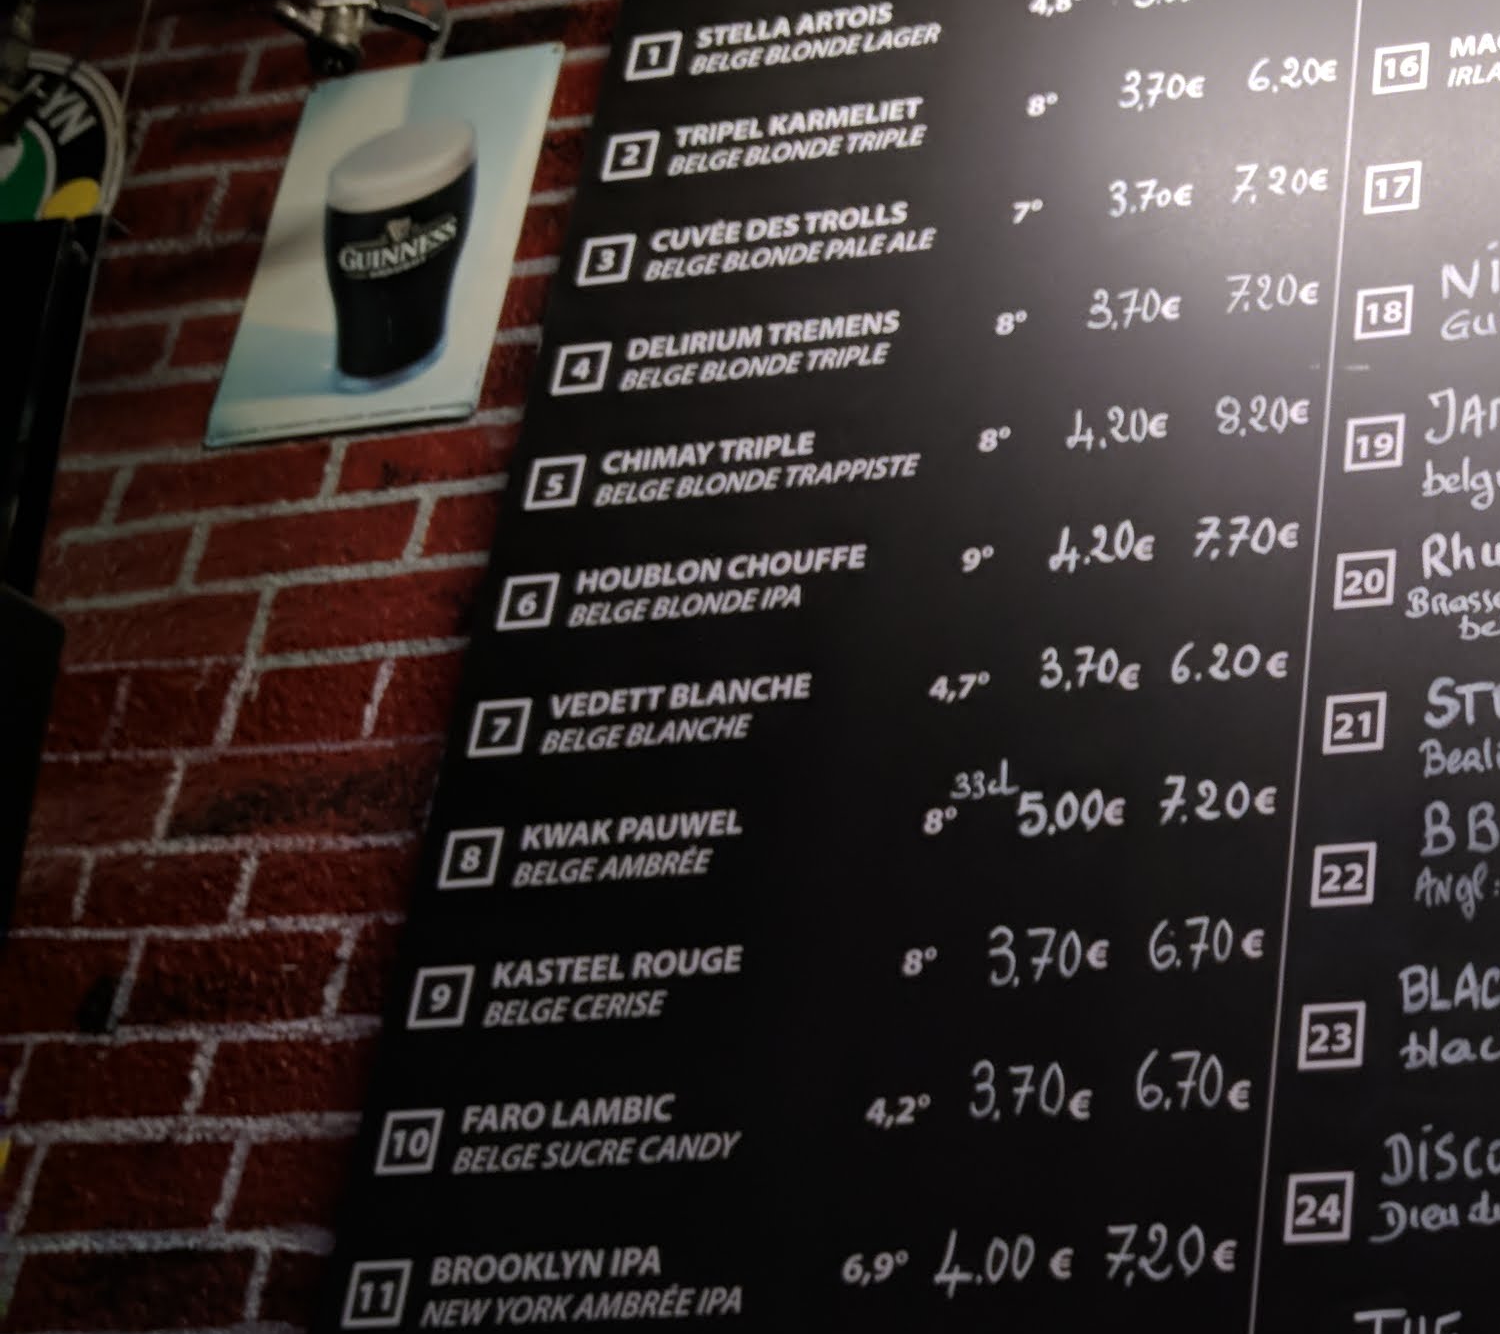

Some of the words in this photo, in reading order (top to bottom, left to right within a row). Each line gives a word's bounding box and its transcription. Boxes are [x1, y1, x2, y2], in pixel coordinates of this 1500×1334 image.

[694, 15, 792, 50] STELLA
[793, 1, 894, 37] ARTOIS
[688, 45, 766, 77] BELGE
[762, 32, 864, 67] BLONDE
[860, 21, 943, 54] LAGER
[674, 116, 765, 149] TRIPEL
[766, 95, 925, 138] KARMELIET
[666, 146, 745, 178] BELGE
[741, 133, 845, 168] BLONDE
[845, 123, 928, 155] TRIPLE
[1373, 171, 1416, 201] 17
[337, 216, 458, 273] GUINNESS
[649, 218, 744, 254] CUVÉE
[743, 213, 801, 243] DES
[803, 200, 909, 236] TROLLS
[642, 251, 723, 283] BELGE
[719, 239, 825, 274] BLONDE
[822, 232, 889, 262] PALE
[884, 226, 938, 255] ALE
[625, 323, 765, 363] DELIRIUM
[766, 308, 901, 347] TREMENS
[1365, 299, 1404, 327] 18
[618, 361, 700, 393] BELGE
[697, 350, 805, 385] BLONDE
[805, 341, 892, 372] TRIPLE
[600, 440, 717, 476] CHIMAY
[717, 430, 817, 464] TRIPLE
[1351, 431, 1395, 461] 19
[592, 476, 676, 508] BELGE
[673, 465, 783, 500] BLONDE
[784, 451, 922, 489] TRAPPISTE
[574, 556, 724, 596] HOUBLON
[725, 542, 869, 582] CHOUFFE
[1340, 566, 1386, 598] 20
[566, 596, 652, 629] BELGE
[649, 586, 761, 621] BLONDE
[758, 583, 803, 611] IPA
[549, 684, 667, 721] VEDETT
[667, 671, 814, 711] BLANCHE
[539, 723, 626, 756] BELGE
[623, 712, 754, 749] BLANCHE
[519, 817, 614, 852] KWAK
[615, 807, 744, 844] PAUWEL
[510, 856, 599, 889] BELGE
[596, 844, 714, 882] AMBRÉE
[1317, 861, 1365, 895] 22
[490, 952, 626, 990] KASTEEL
[630, 944, 745, 980] ROUGE
[481, 995, 572, 1029] BELGE
[571, 988, 669, 1023] CERISE
[460, 1100, 547, 1135] FARO
[550, 1092, 677, 1130] LAMBIC
[451, 1141, 543, 1175] BELGE
[540, 1136, 638, 1170] SUCRE
[637, 1130, 743, 1165] CANDY
[1292, 1192, 1342, 1228] 24
[429, 1248, 606, 1287] BROOKLYN
[608, 1244, 663, 1278] IPA
[419, 1297, 493, 1328] NEW
[494, 1293, 575, 1326] YORK
[570, 1282, 697, 1322] AMBRÉE
[694, 1284, 743, 1317] IPA
